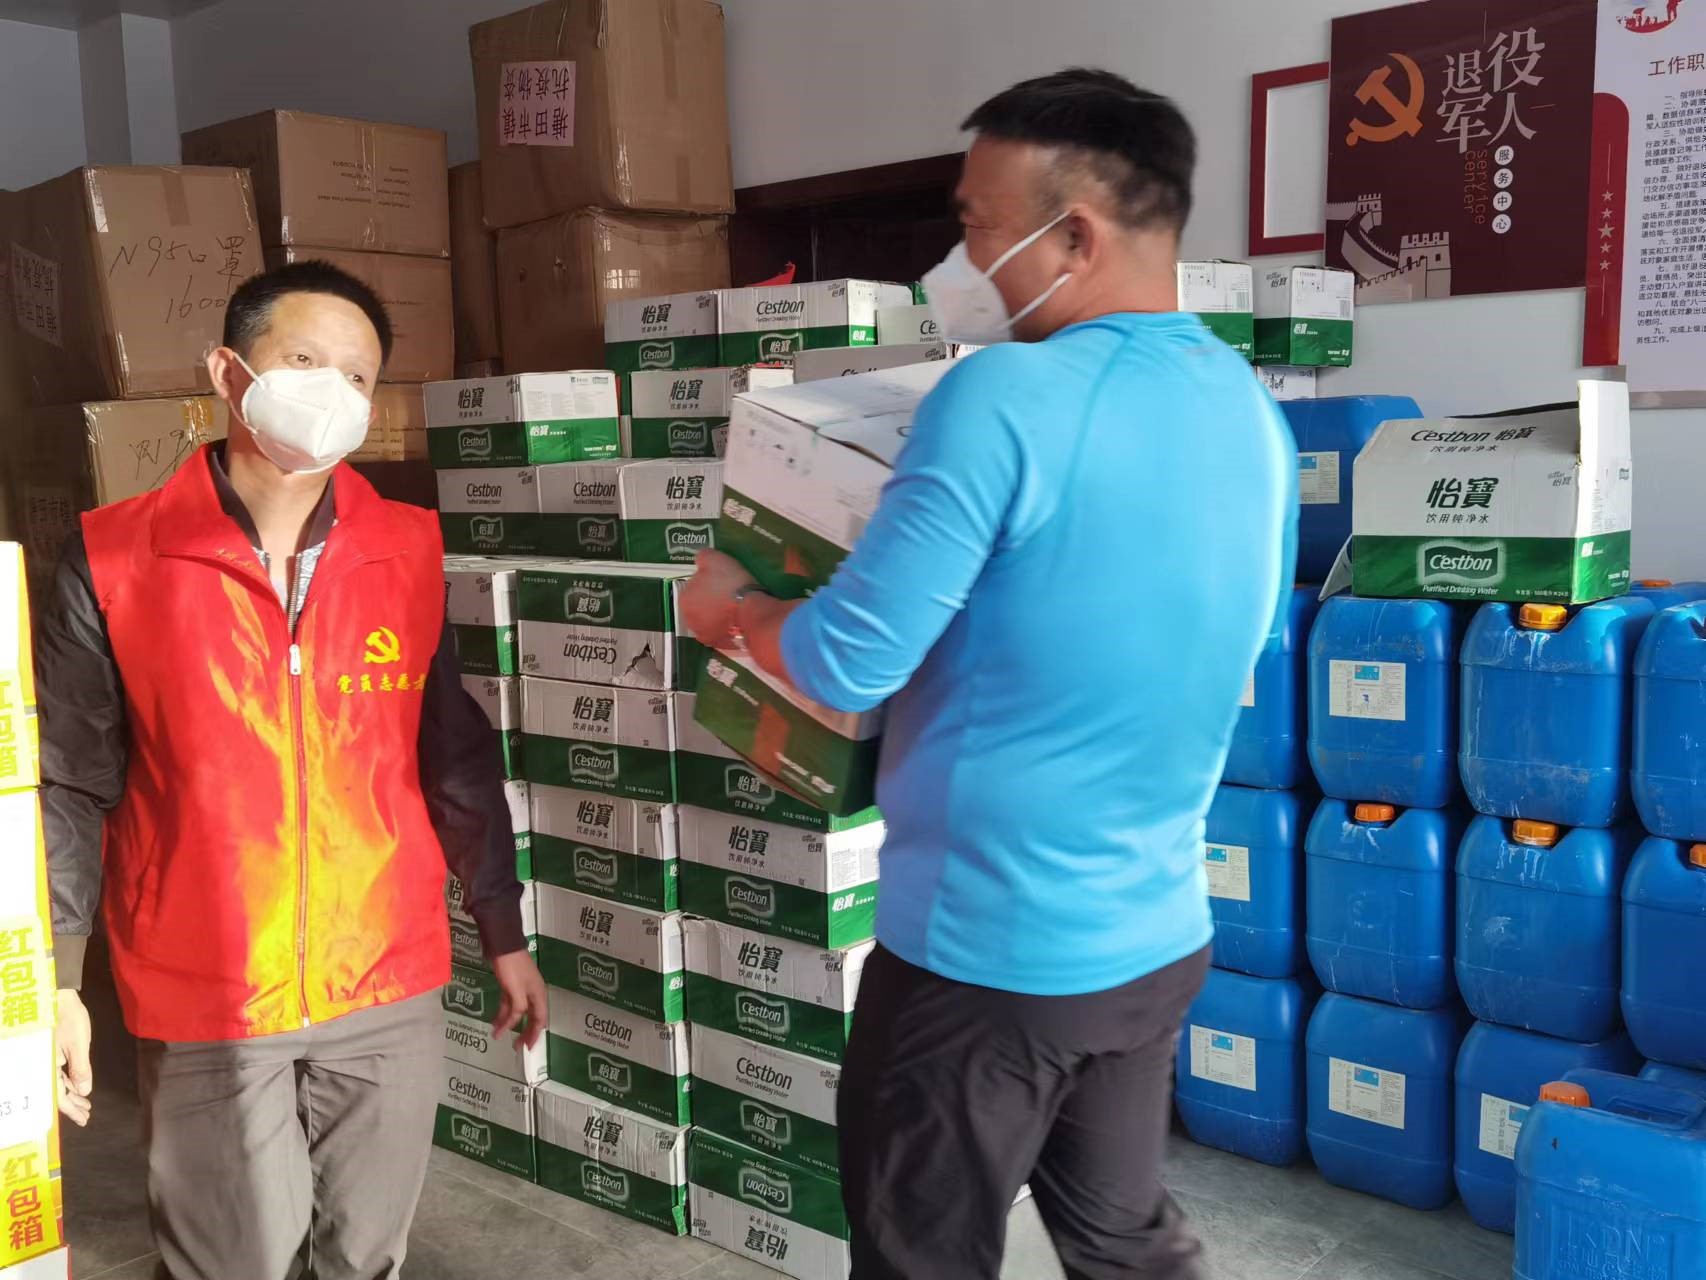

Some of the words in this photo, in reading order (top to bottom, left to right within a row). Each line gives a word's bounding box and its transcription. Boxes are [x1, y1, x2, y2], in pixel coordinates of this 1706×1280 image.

[1441, 27, 1545, 97] 退役
[1436, 91, 1538, 154] 军人
[1464, 150, 1476, 214] center
[1474, 149, 1488, 225] service
[1493, 146, 1513, 233] 服务中心
[665, 475, 705, 500] 怡寶
[1426, 477, 1499, 509] 怡寶
[1426, 513, 1489, 524] 饮用纯净水
[1422, 584, 1449, 594] Purified
[1449, 585, 1476, 596] Drinking
[1477, 587, 1499, 595] Water
[572, 695, 615, 723] 怡寶
[577, 799, 615, 829] 怡寶
[728, 824, 770, 857] 怡寶
[579, 905, 615, 937] 怡寶
[737, 940, 784, 973] 怡寶
[583, 1115, 624, 1148] 怡寶
[3, 1151, 45, 1252] 红包箱
[744, 1225, 789, 1261] 怡寶
